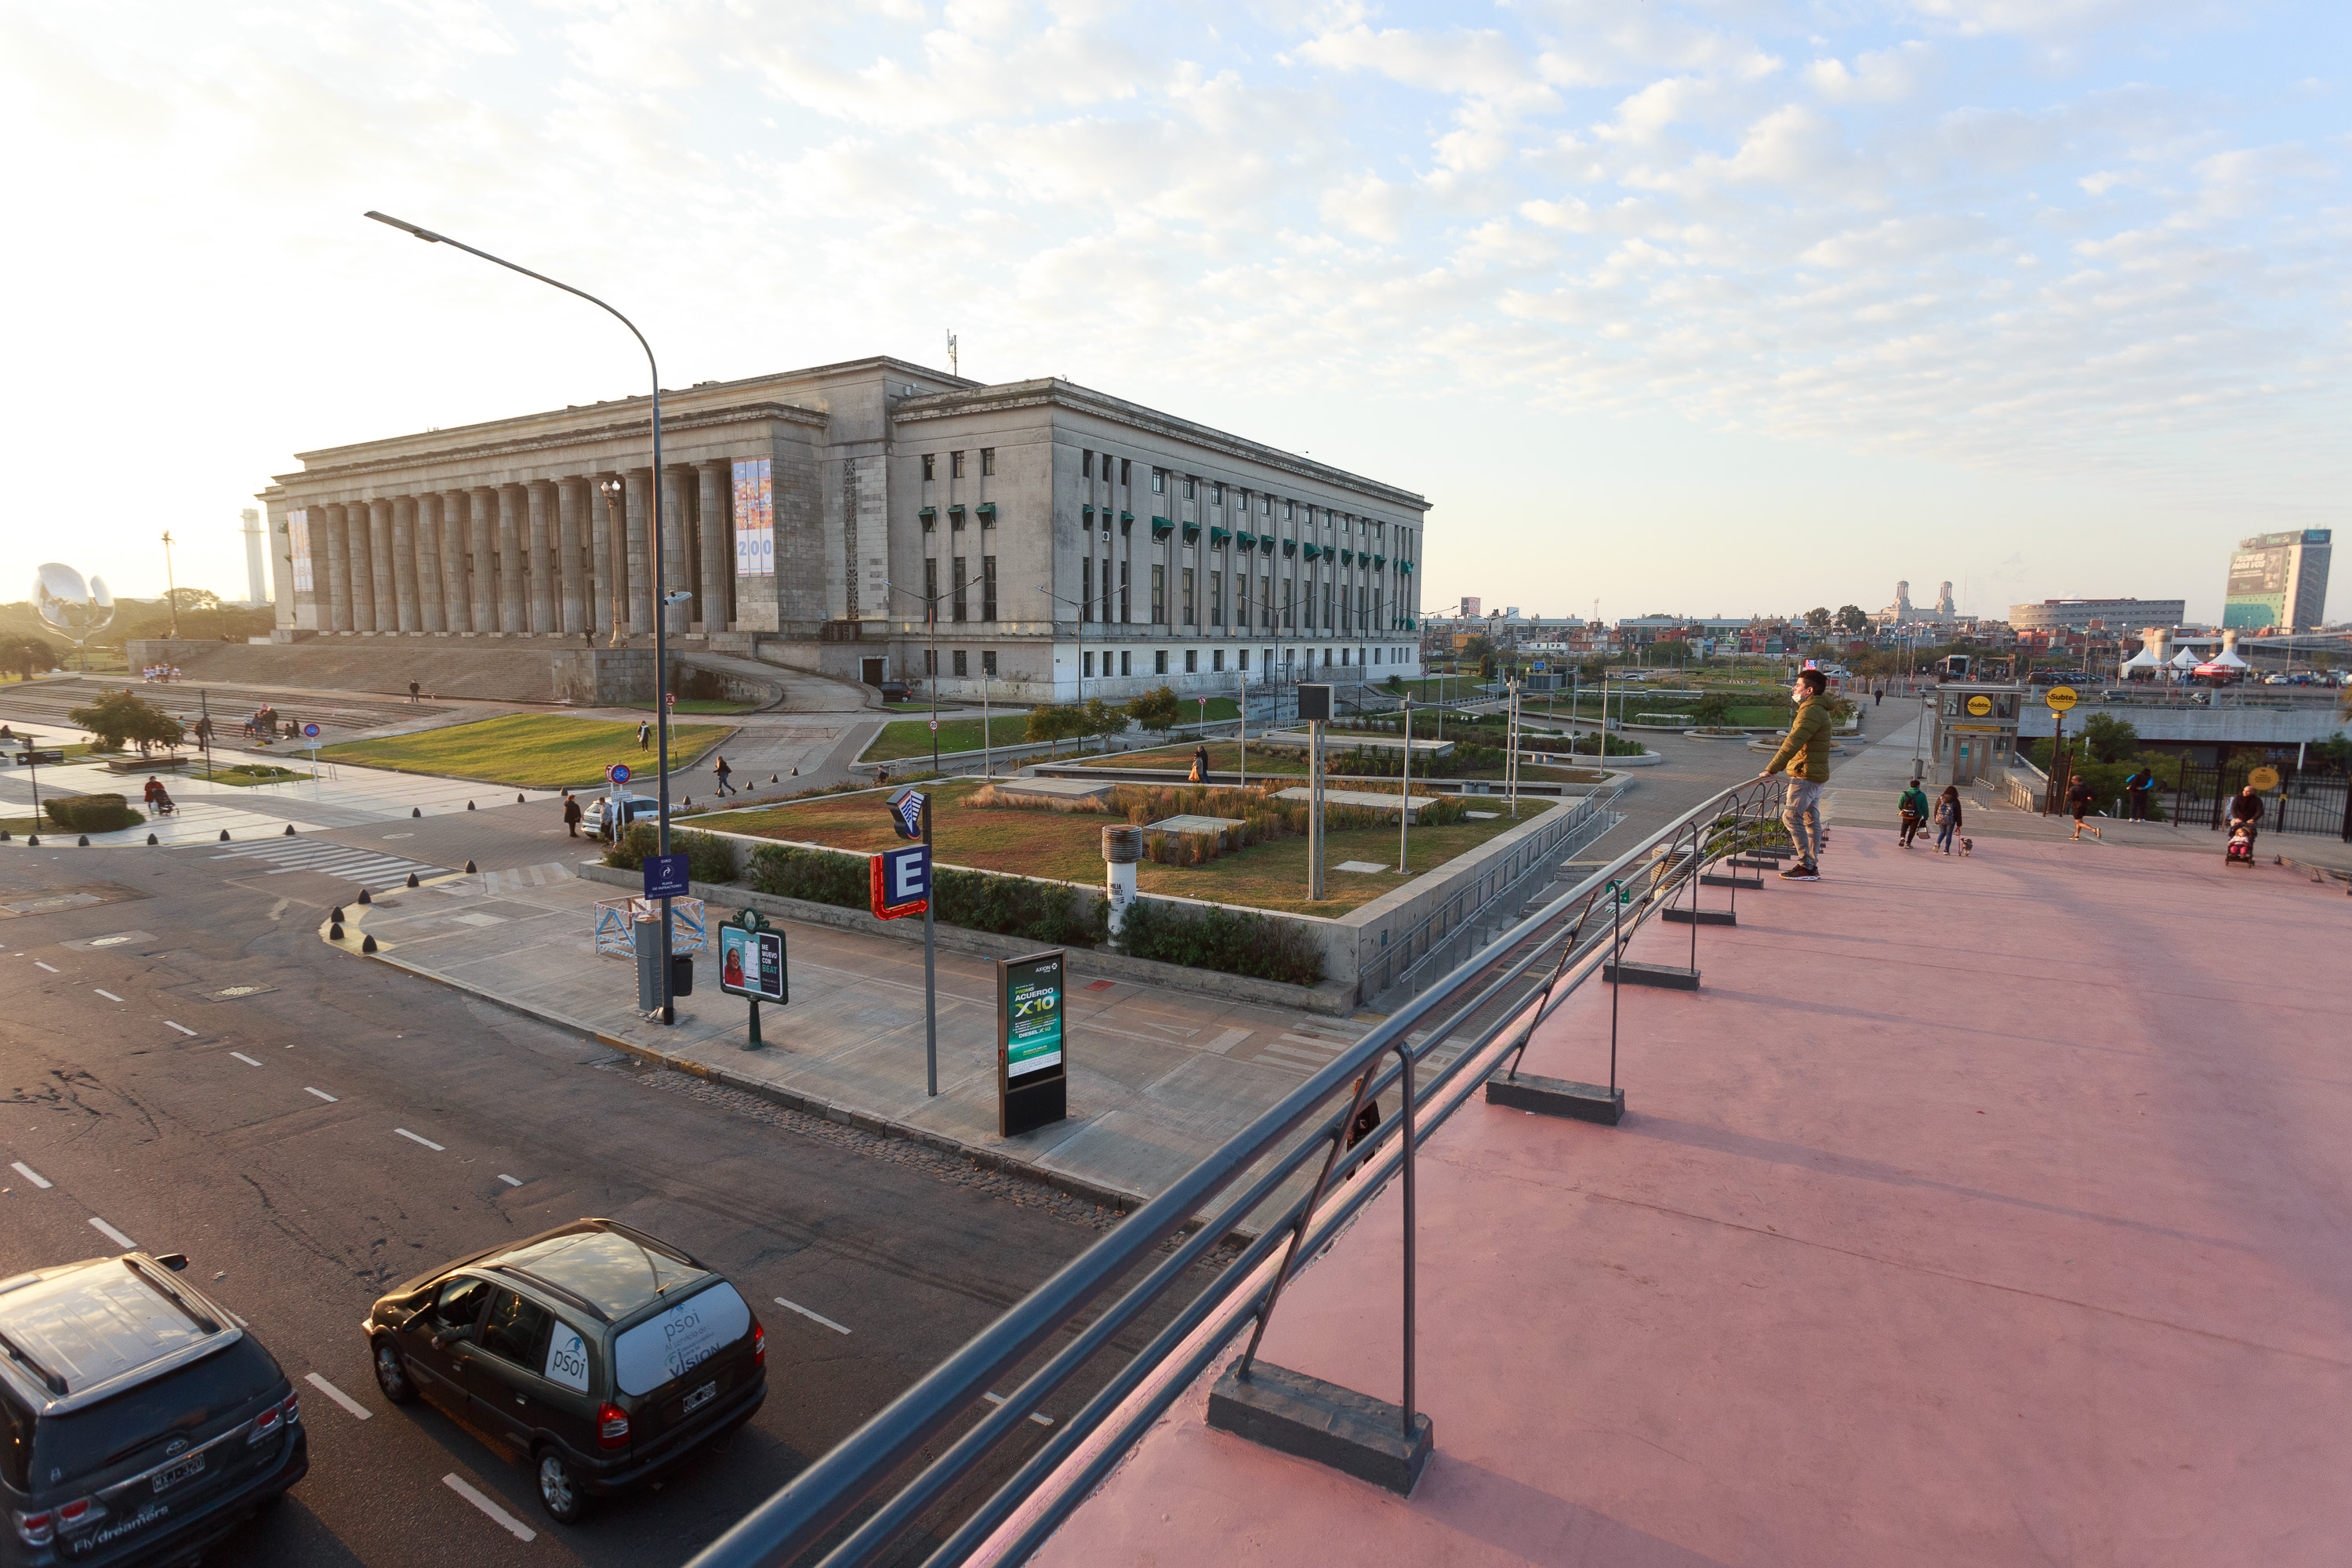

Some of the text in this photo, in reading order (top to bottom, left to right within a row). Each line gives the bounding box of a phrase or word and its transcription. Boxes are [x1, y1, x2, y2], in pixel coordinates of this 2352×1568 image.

[739, 539, 771, 556] 200
[2252, 560, 2266, 568] VOS
[896, 851, 924, 898] E
[761, 950, 778, 959] MUEVO
[762, 964, 778, 975] BEAT
[1014, 987, 1054, 1002] ACUERDO
[1015, 986, 1034, 995] PROMO
[1015, 996, 1054, 1018] X10
[1018, 1029, 1039, 1039] DIESEL
[663, 1308, 700, 1342] psoi
[552, 1349, 586, 1380] psoi
[183, 1457, 203, 1475] 320
